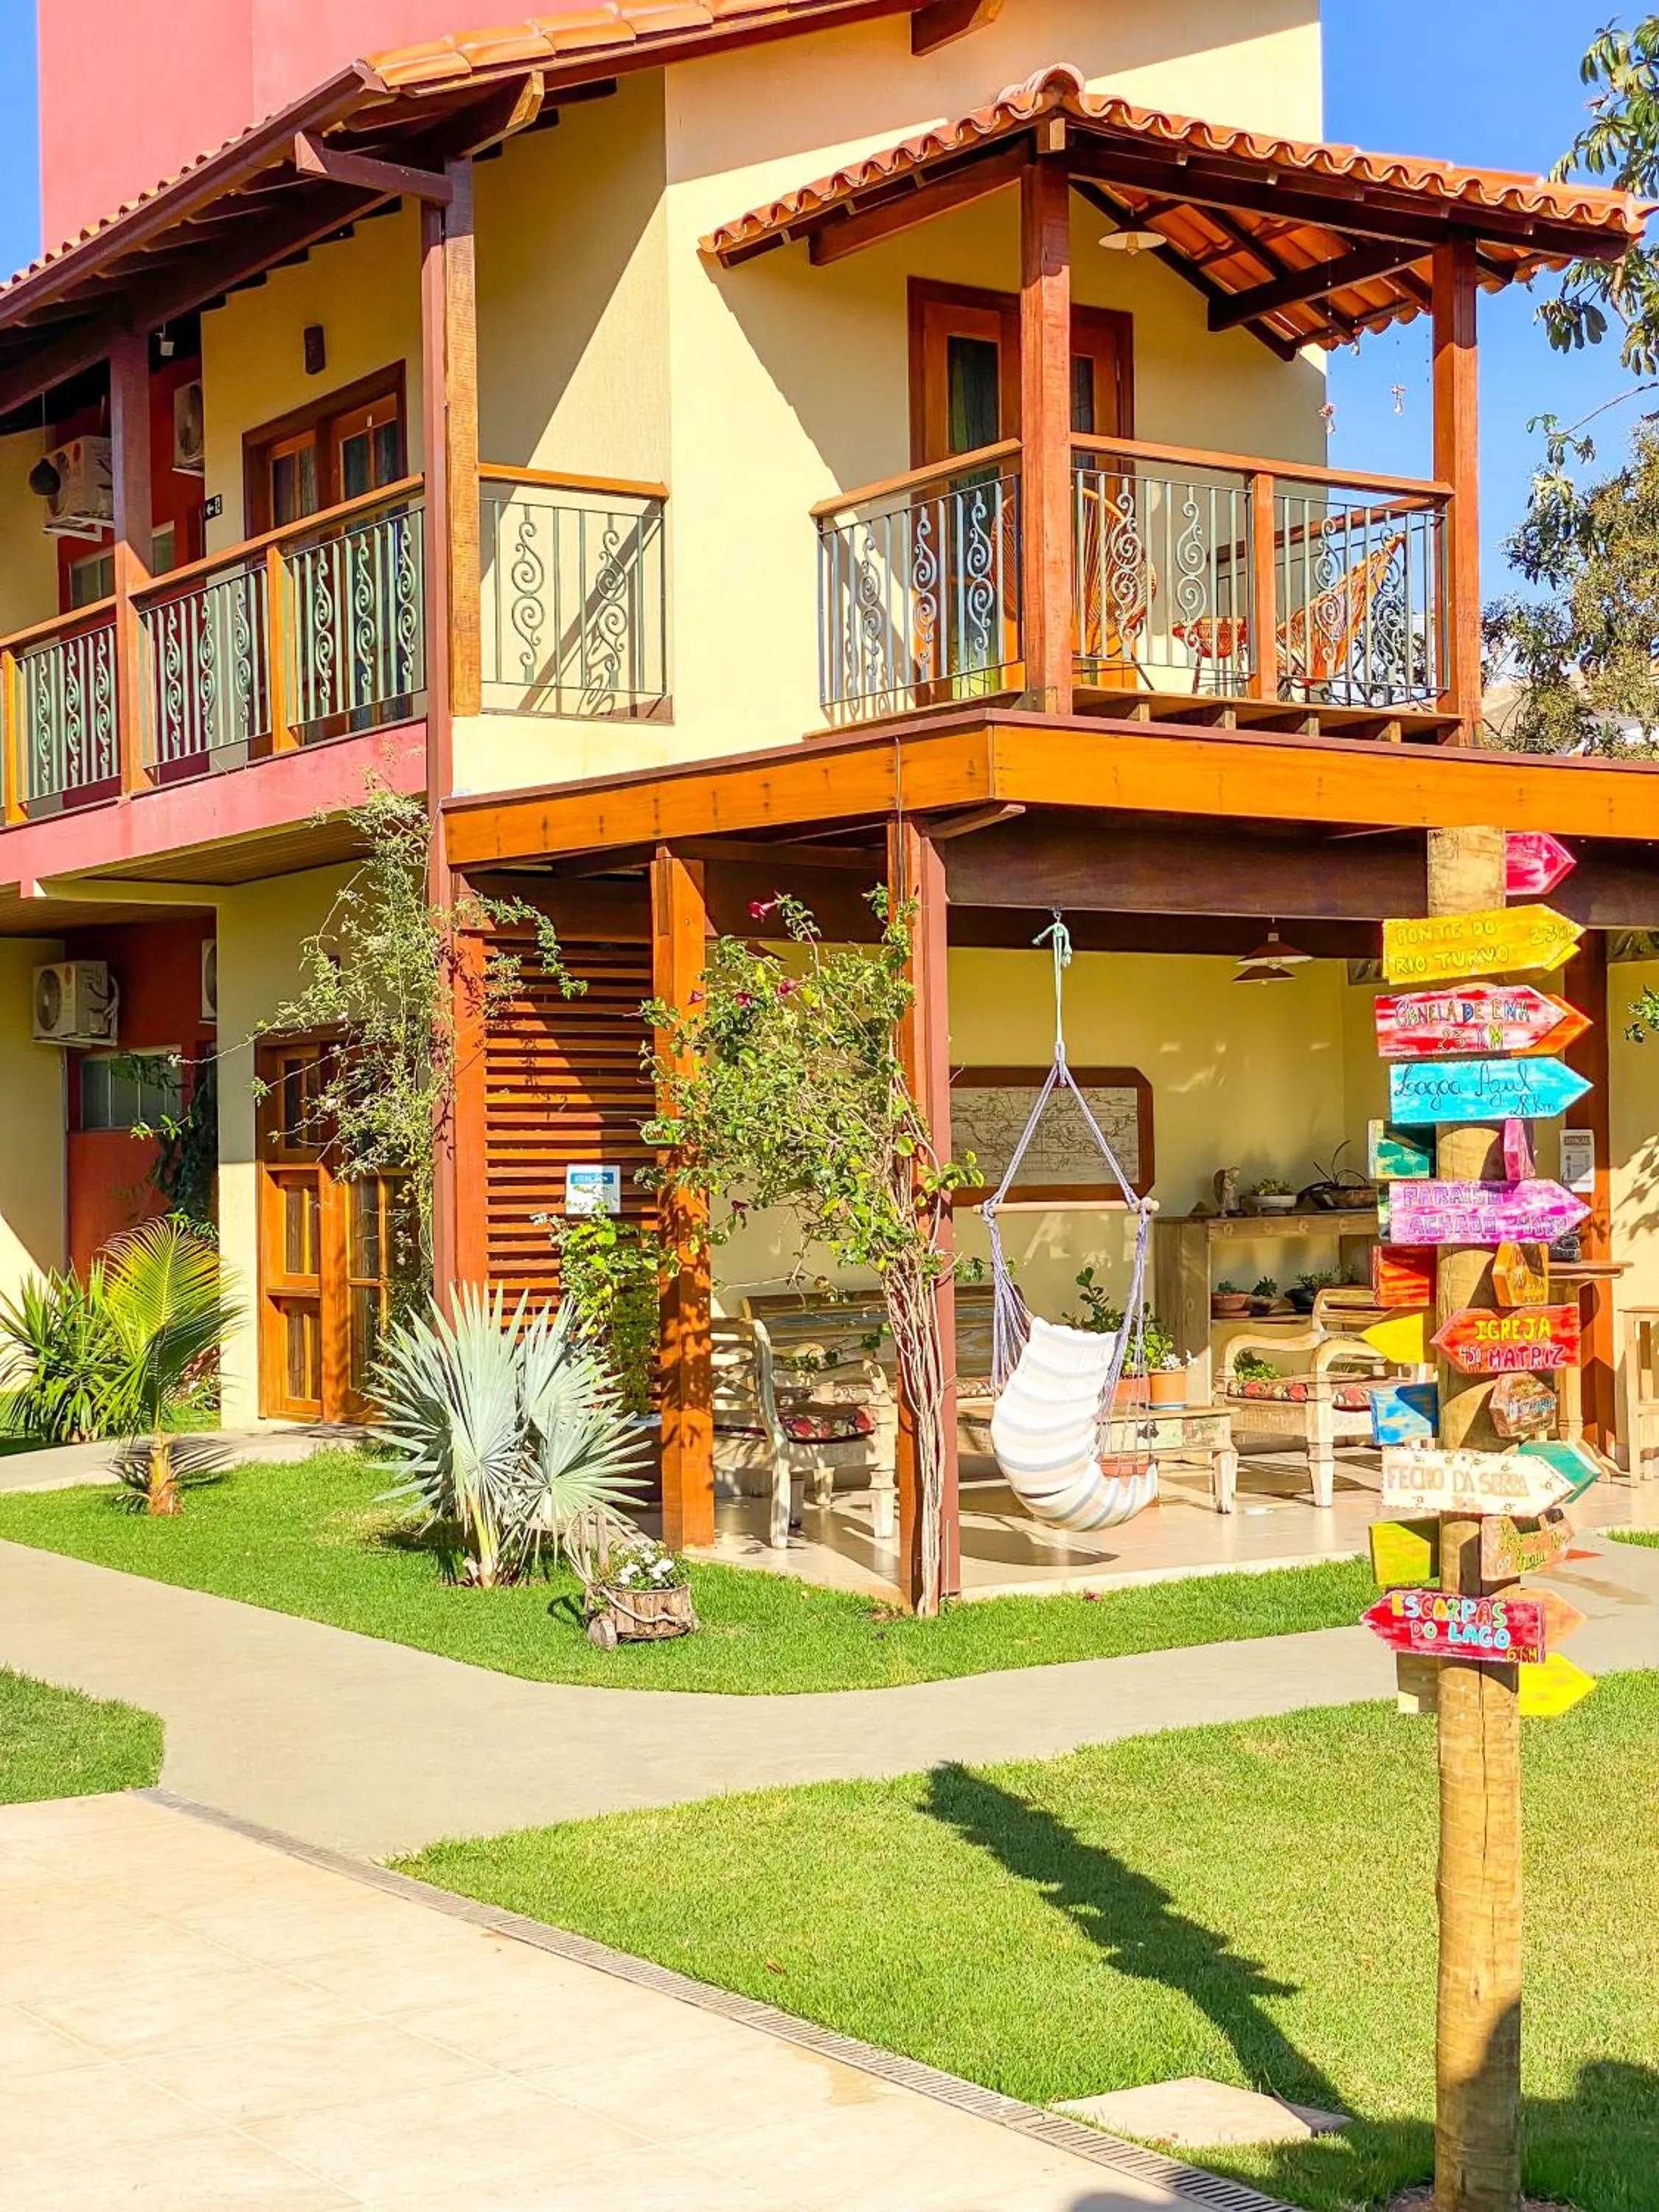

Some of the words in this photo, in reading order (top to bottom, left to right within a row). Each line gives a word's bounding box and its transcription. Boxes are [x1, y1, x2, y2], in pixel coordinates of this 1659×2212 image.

[1396, 920, 1464, 946] PONTE
[1472, 919, 1498, 936] DO
[1394, 956, 1427, 975] RIO
[1433, 945, 1509, 970] TURVO
[1461, 1001, 1485, 1023] DE
[1394, 1063, 1463, 1111] Lagoa
[1475, 1062, 1533, 1108] Azul
[1475, 1316, 1551, 1340] IGREJA
[1488, 1343, 1567, 1371] MATRIZ
[1387, 1464, 1444, 1490] FECHO
[1453, 1470, 1475, 1493] DA
[1391, 1593, 1508, 1629] ESCARPAS
[1410, 1620, 1437, 1639] DO
[1447, 1621, 1511, 1650] LAGO
